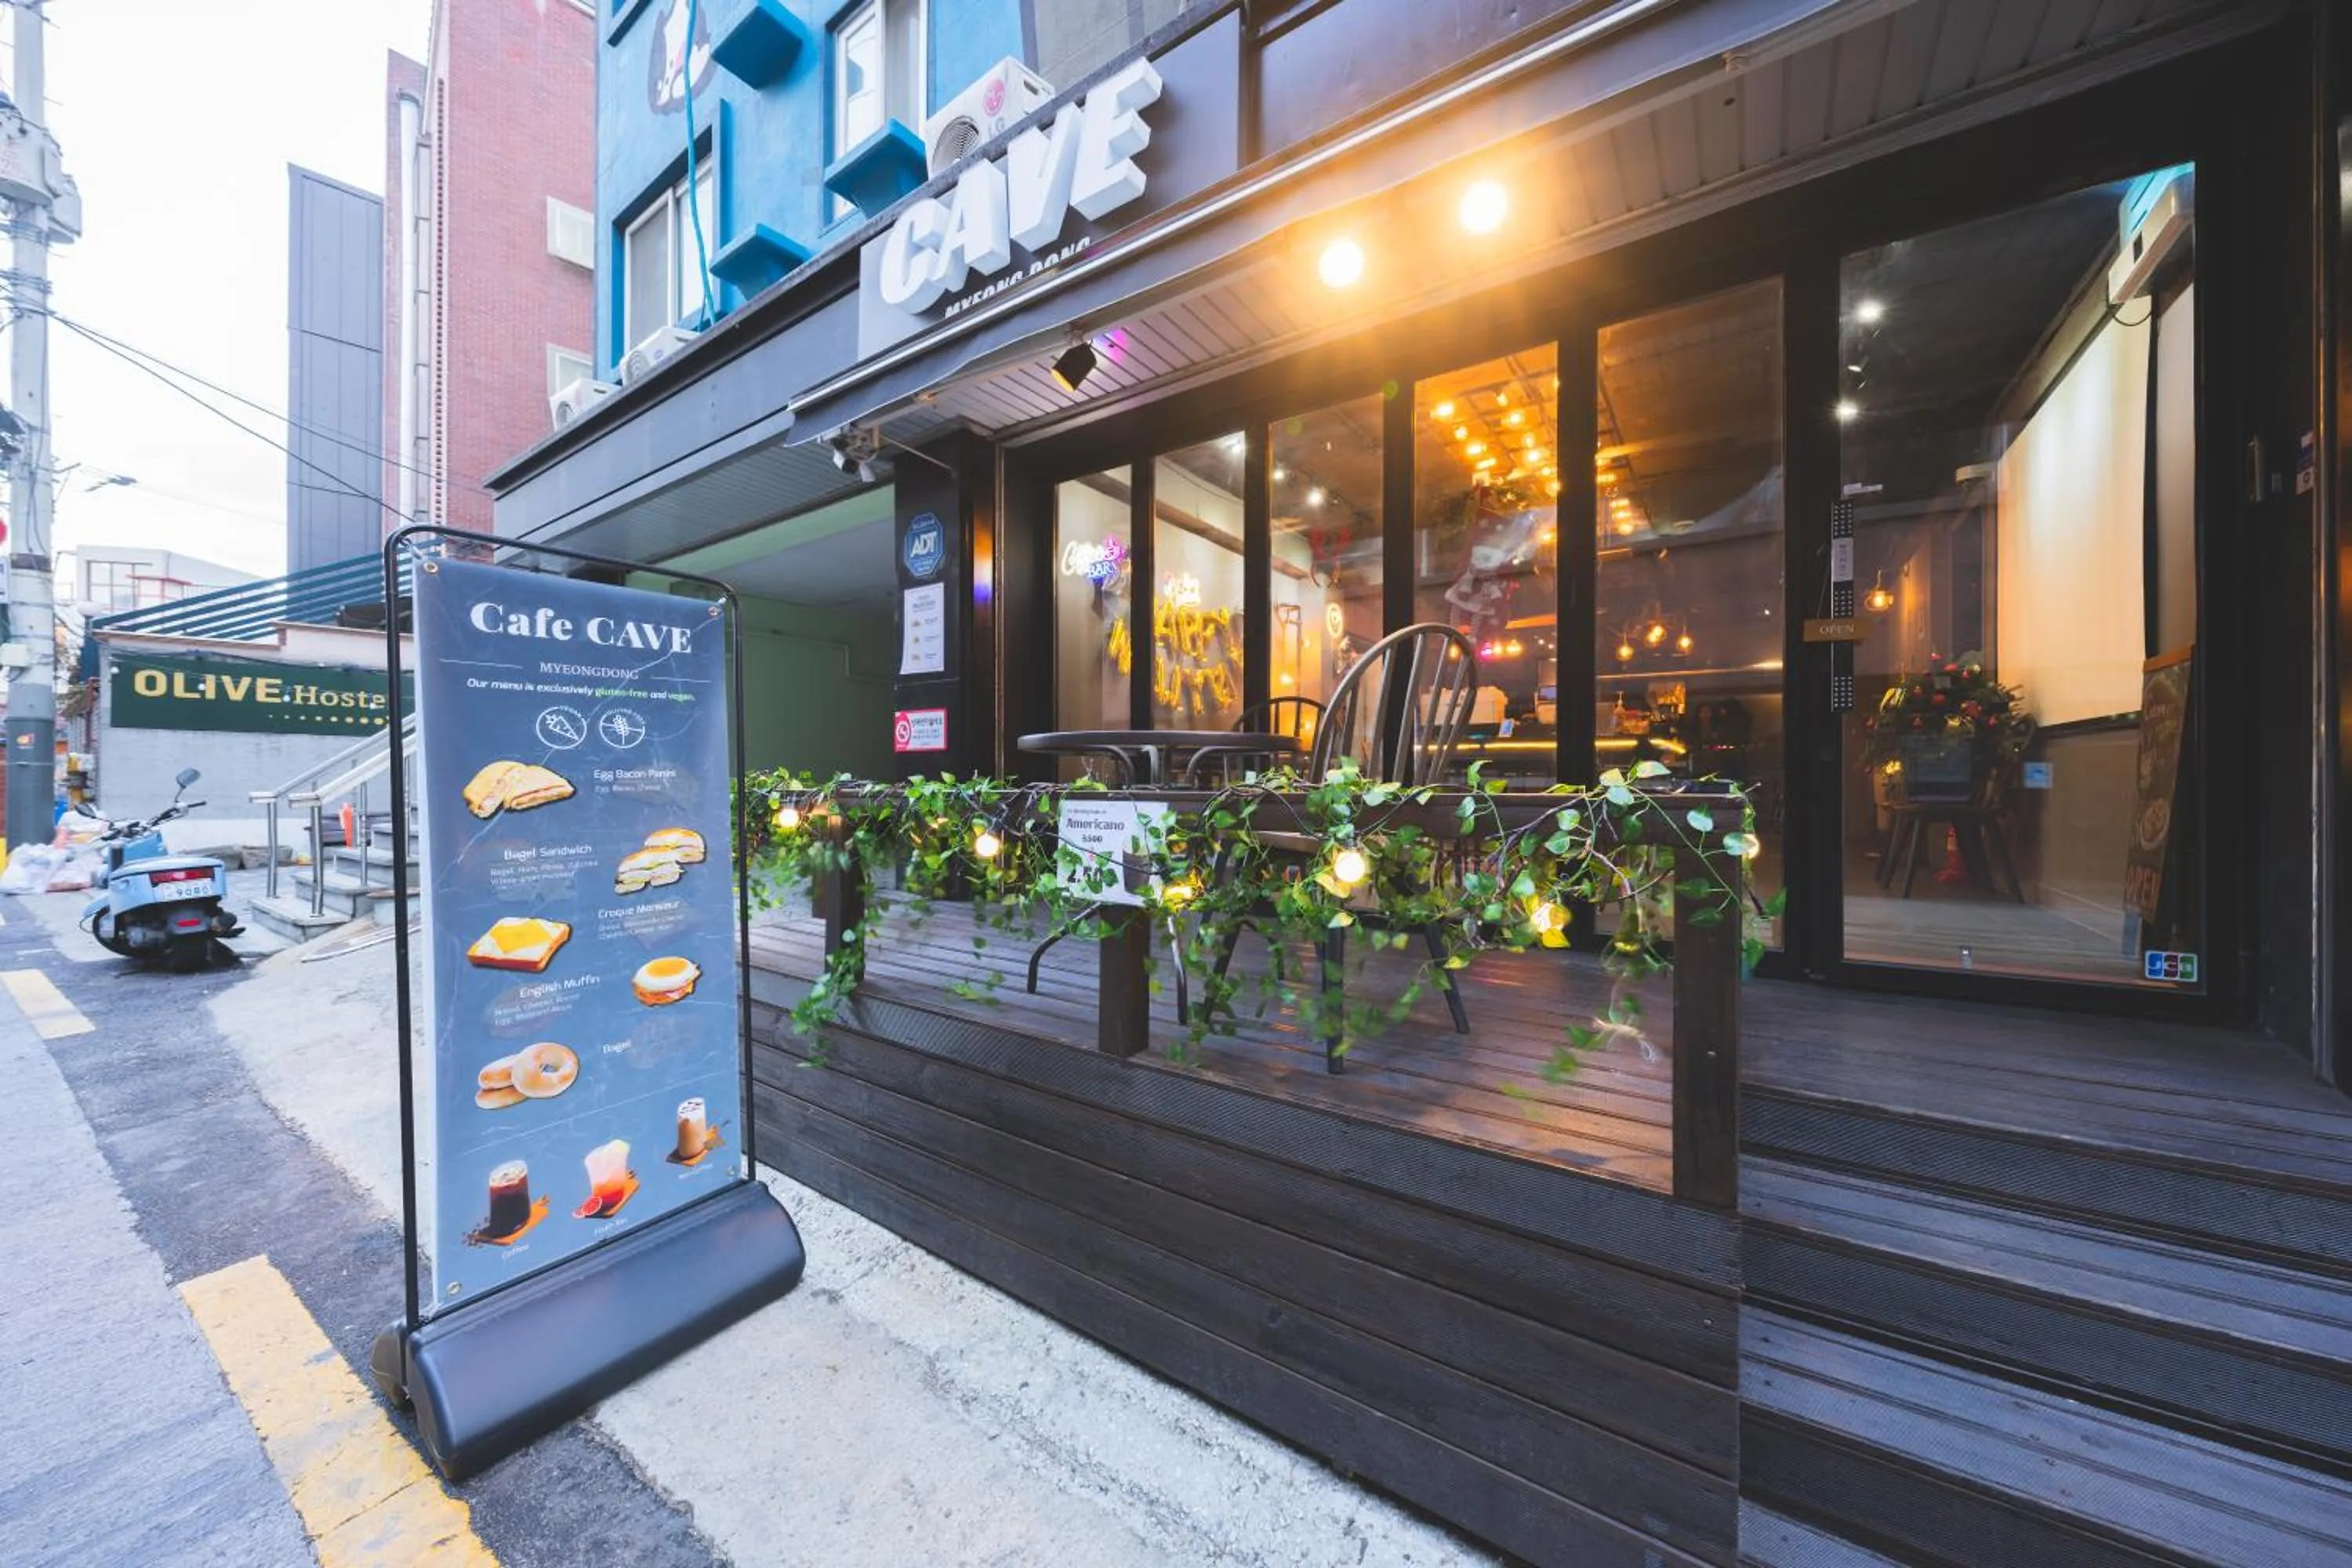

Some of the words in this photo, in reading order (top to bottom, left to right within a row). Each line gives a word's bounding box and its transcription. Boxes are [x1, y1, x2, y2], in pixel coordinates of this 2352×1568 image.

[880, 56, 1163, 314] CAVE
[910, 532, 938, 557] ADT
[470, 602, 573, 641] Cafe
[586, 617, 692, 654] CAVE
[539, 662, 640, 680] MYEONGDONG
[134, 670, 284, 704] OLIVE
[293, 684, 387, 710] Hoste
[466, 677, 488, 688] Our
[491, 681, 523, 691] menu
[536, 683, 593, 696] exclusively
[593, 769, 614, 781] Egg
[615, 769, 647, 779] Bacon
[1065, 818, 1126, 831] Americano
[539, 844, 592, 857] Sandwich
[598, 906, 634, 919] Croque
[520, 982, 562, 998] English
[564, 974, 601, 989] Muffin
